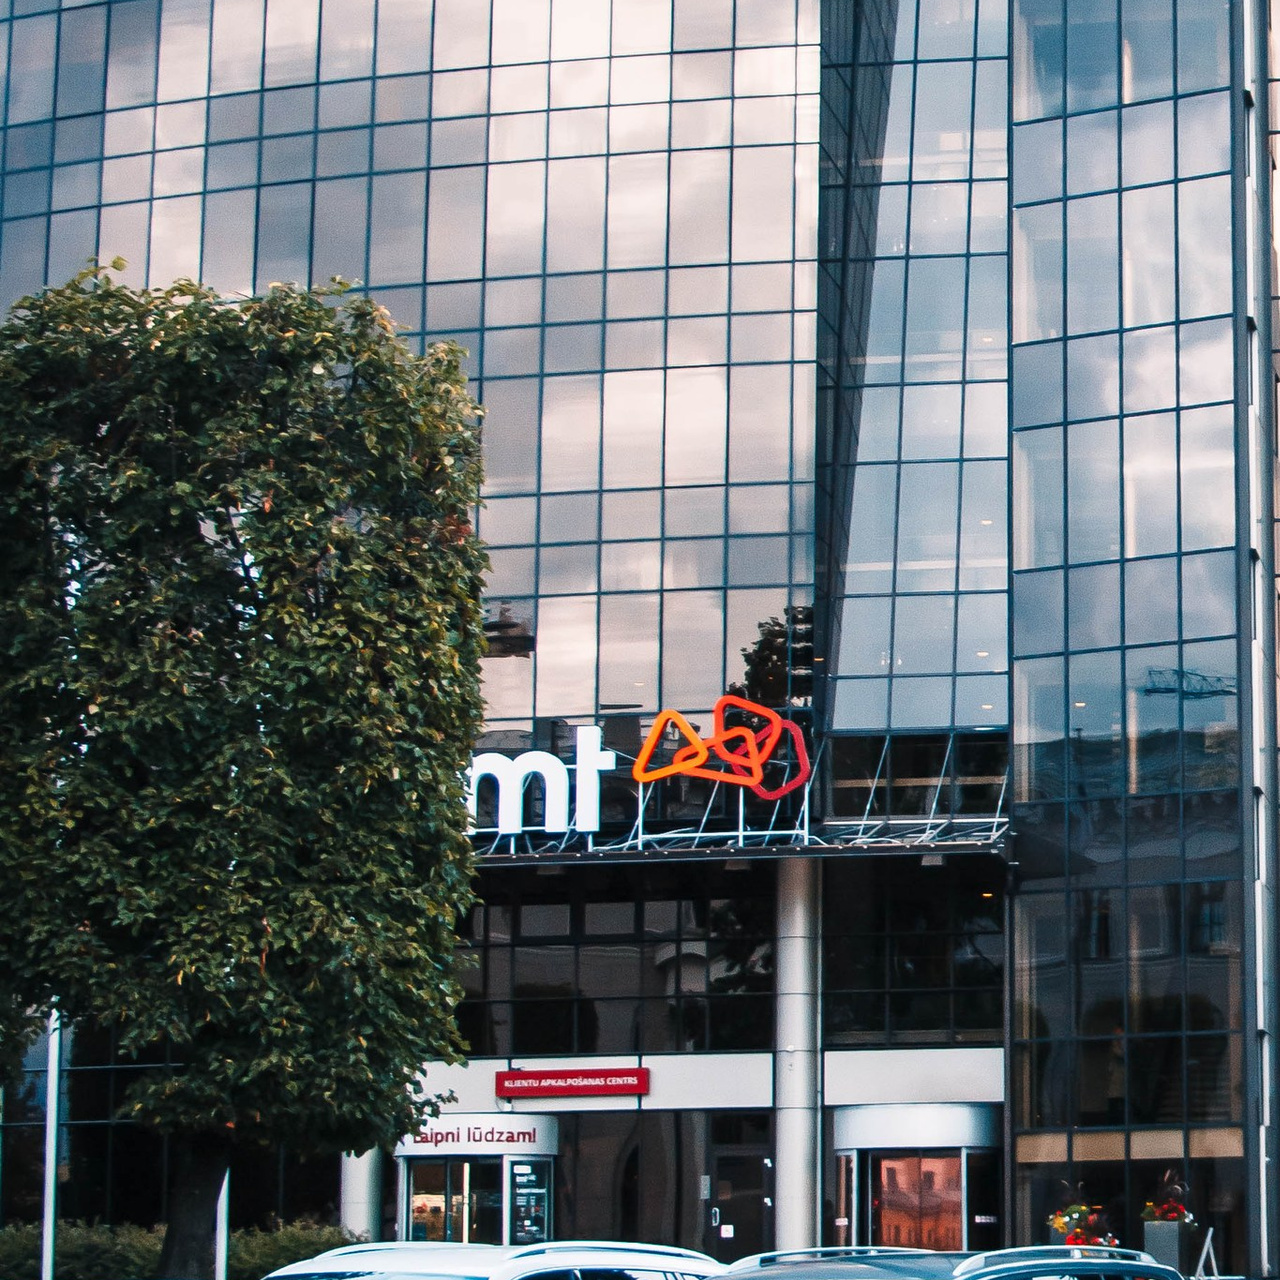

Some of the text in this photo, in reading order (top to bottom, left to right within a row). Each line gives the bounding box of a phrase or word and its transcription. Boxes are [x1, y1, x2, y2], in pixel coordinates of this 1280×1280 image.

[465, 725, 617, 835] mt
[504, 1075, 638, 1087] KLIENTU APKALPOŠANAS CENTRS
